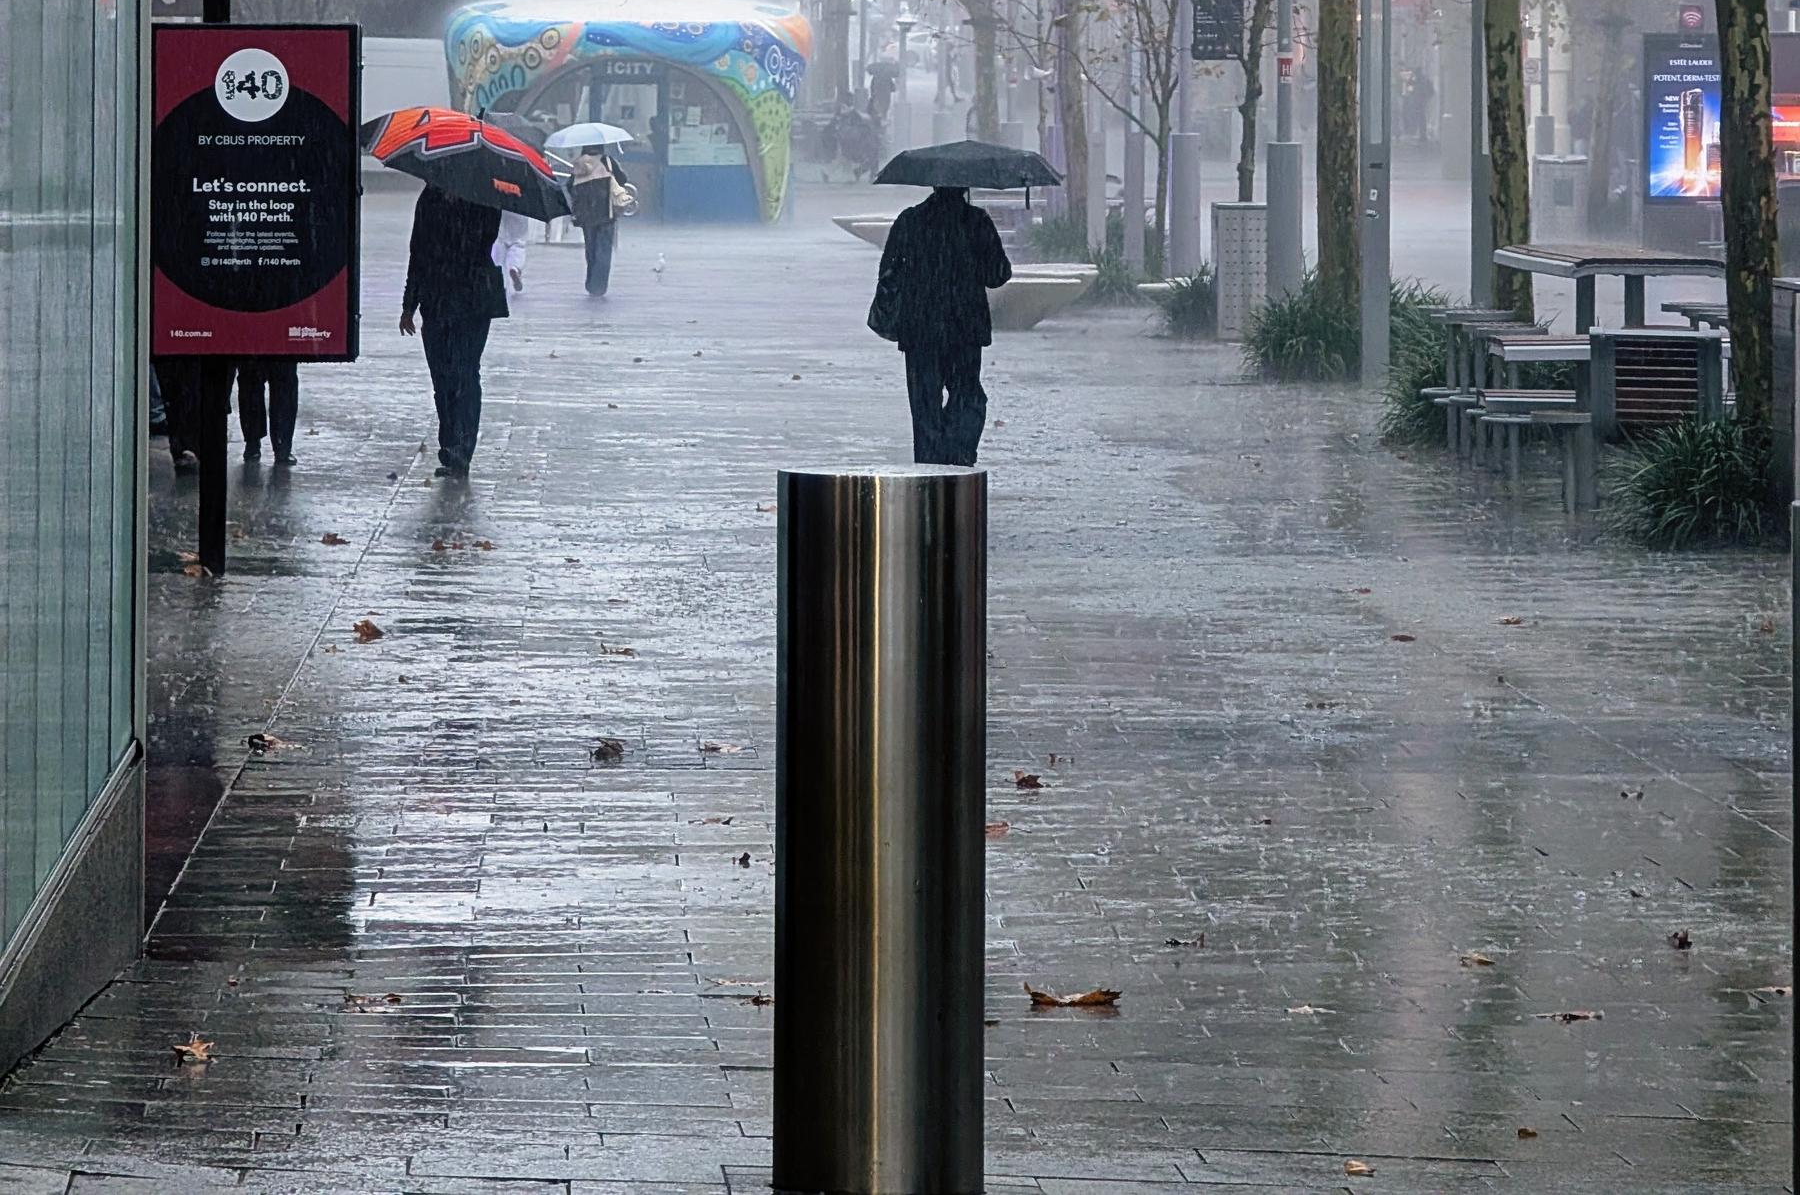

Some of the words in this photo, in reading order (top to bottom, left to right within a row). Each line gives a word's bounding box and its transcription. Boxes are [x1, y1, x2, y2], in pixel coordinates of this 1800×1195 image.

[1682, 74, 1721, 82] DERM-TEST
[221, 70, 283, 100] 140
[198, 135, 213, 145] BY
[215, 135, 245, 145] CBUS
[247, 135, 305, 145] PROPERTY
[192, 177, 234, 193] Let's
[236, 179, 311, 193] connect.
[208, 199, 234, 212] Stay
[236, 200, 247, 210] in
[248, 199, 268, 210] the
[269, 199, 295, 212] loop
[209, 212, 235, 222] with
[236, 211, 257, 222] 140
[260, 212, 294, 222] Perth.
[280, 258, 301, 266] Perth
[170, 329, 213, 337] 140.com.au
